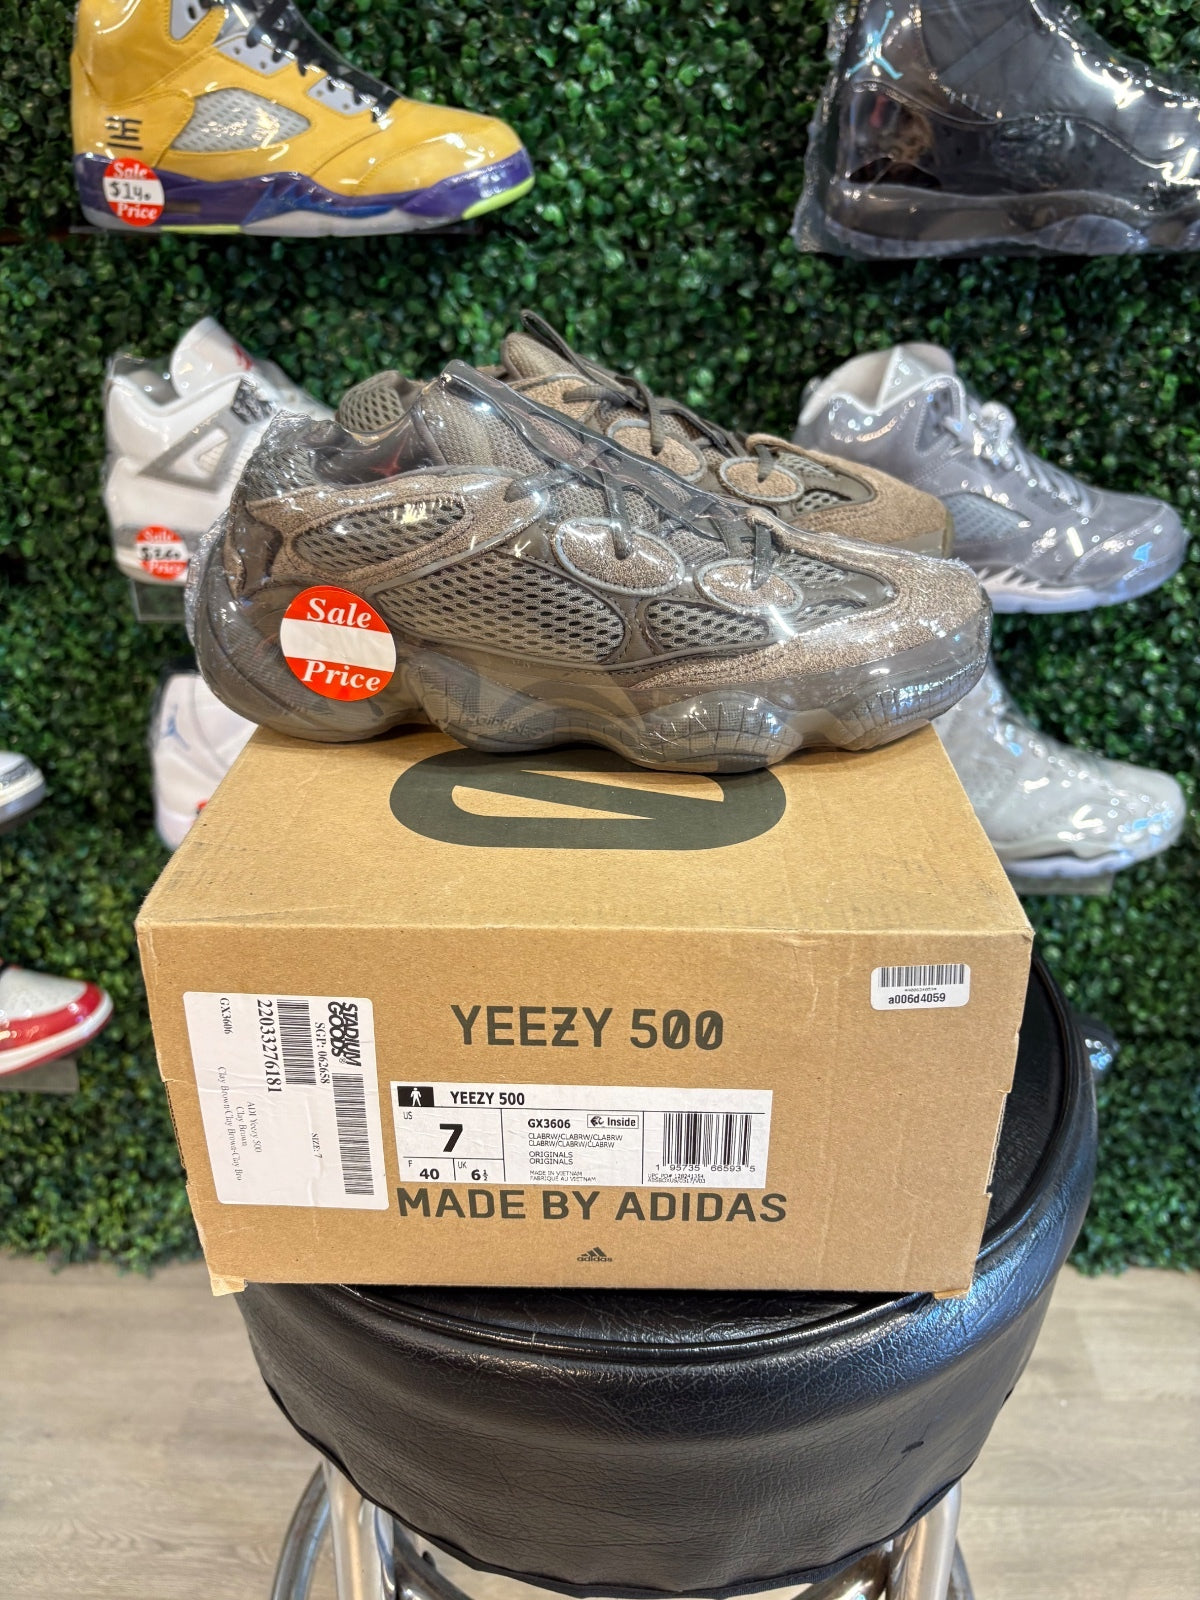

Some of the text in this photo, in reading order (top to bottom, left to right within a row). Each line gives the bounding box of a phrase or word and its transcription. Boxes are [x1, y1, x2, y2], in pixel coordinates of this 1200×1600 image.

[113, 161, 149, 179] Sale
[117, 202, 158, 220] Price
[306, 597, 372, 628] Sale
[301, 660, 381, 691] Price
[219, 997, 234, 1035] GX3606
[342, 1002, 362, 1067] STADIUM
[450, 1004, 724, 1051] YEEZY 500
[257, 999, 283, 1093] 22033276181
[315, 1022, 331, 1084] SGP: 062658
[218, 1066, 226, 1084] Clay
[450, 1090, 525, 1106] YEEZY 500
[236, 1106, 246, 1122] Clay
[403, 1111, 413, 1120] US
[607, 1117, 636, 1127] Inside
[527, 1118, 571, 1129] GX3606
[312, 1132, 321, 1152] SIZE:
[439, 1123, 464, 1153] 7
[408, 1160, 413, 1168] F
[528, 1151, 574, 1159] ORIGINALS
[457, 1160, 467, 1169] UK
[669, 1164, 701, 1172] 95735
[419, 1168, 440, 1180] 40
[397, 1188, 788, 1223] MADE BY ADIDAS
